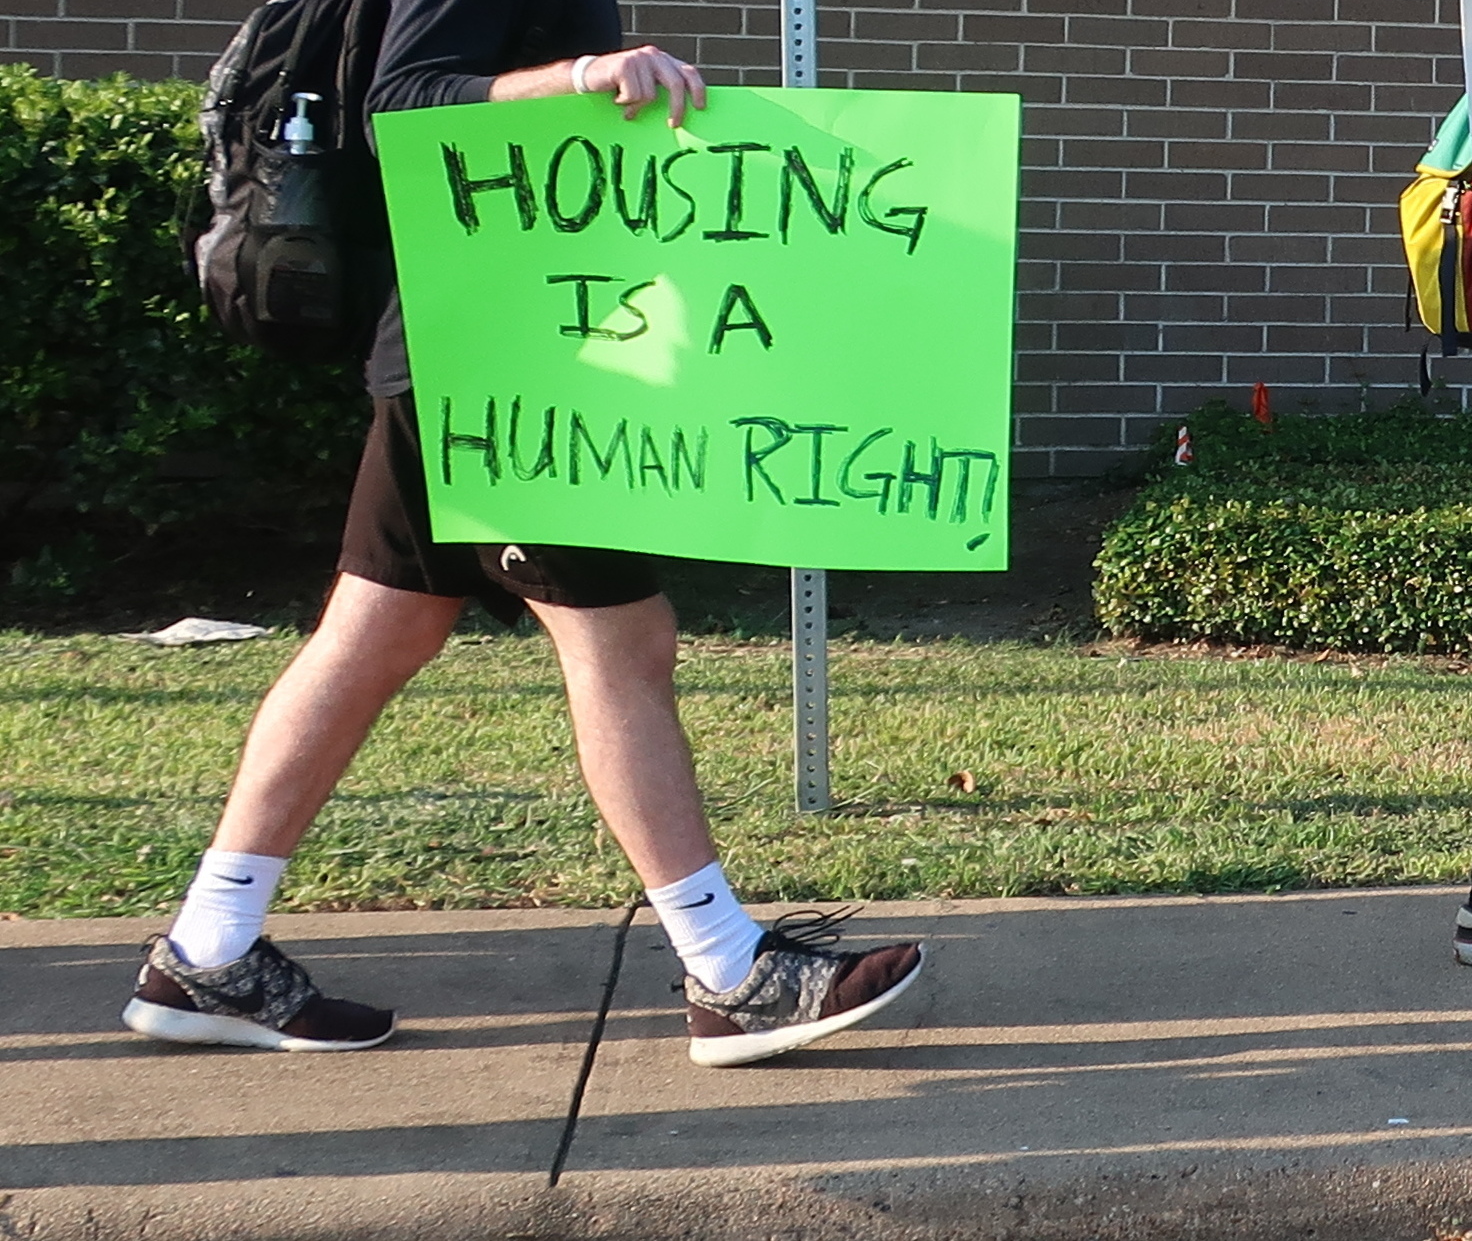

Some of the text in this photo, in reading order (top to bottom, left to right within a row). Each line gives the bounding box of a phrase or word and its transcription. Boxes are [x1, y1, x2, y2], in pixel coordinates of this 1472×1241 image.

[440, 135, 928, 255] HOUSING
[546, 274, 773, 354] IS A
[440, 394, 1000, 551] HUMAN RIGHT!
